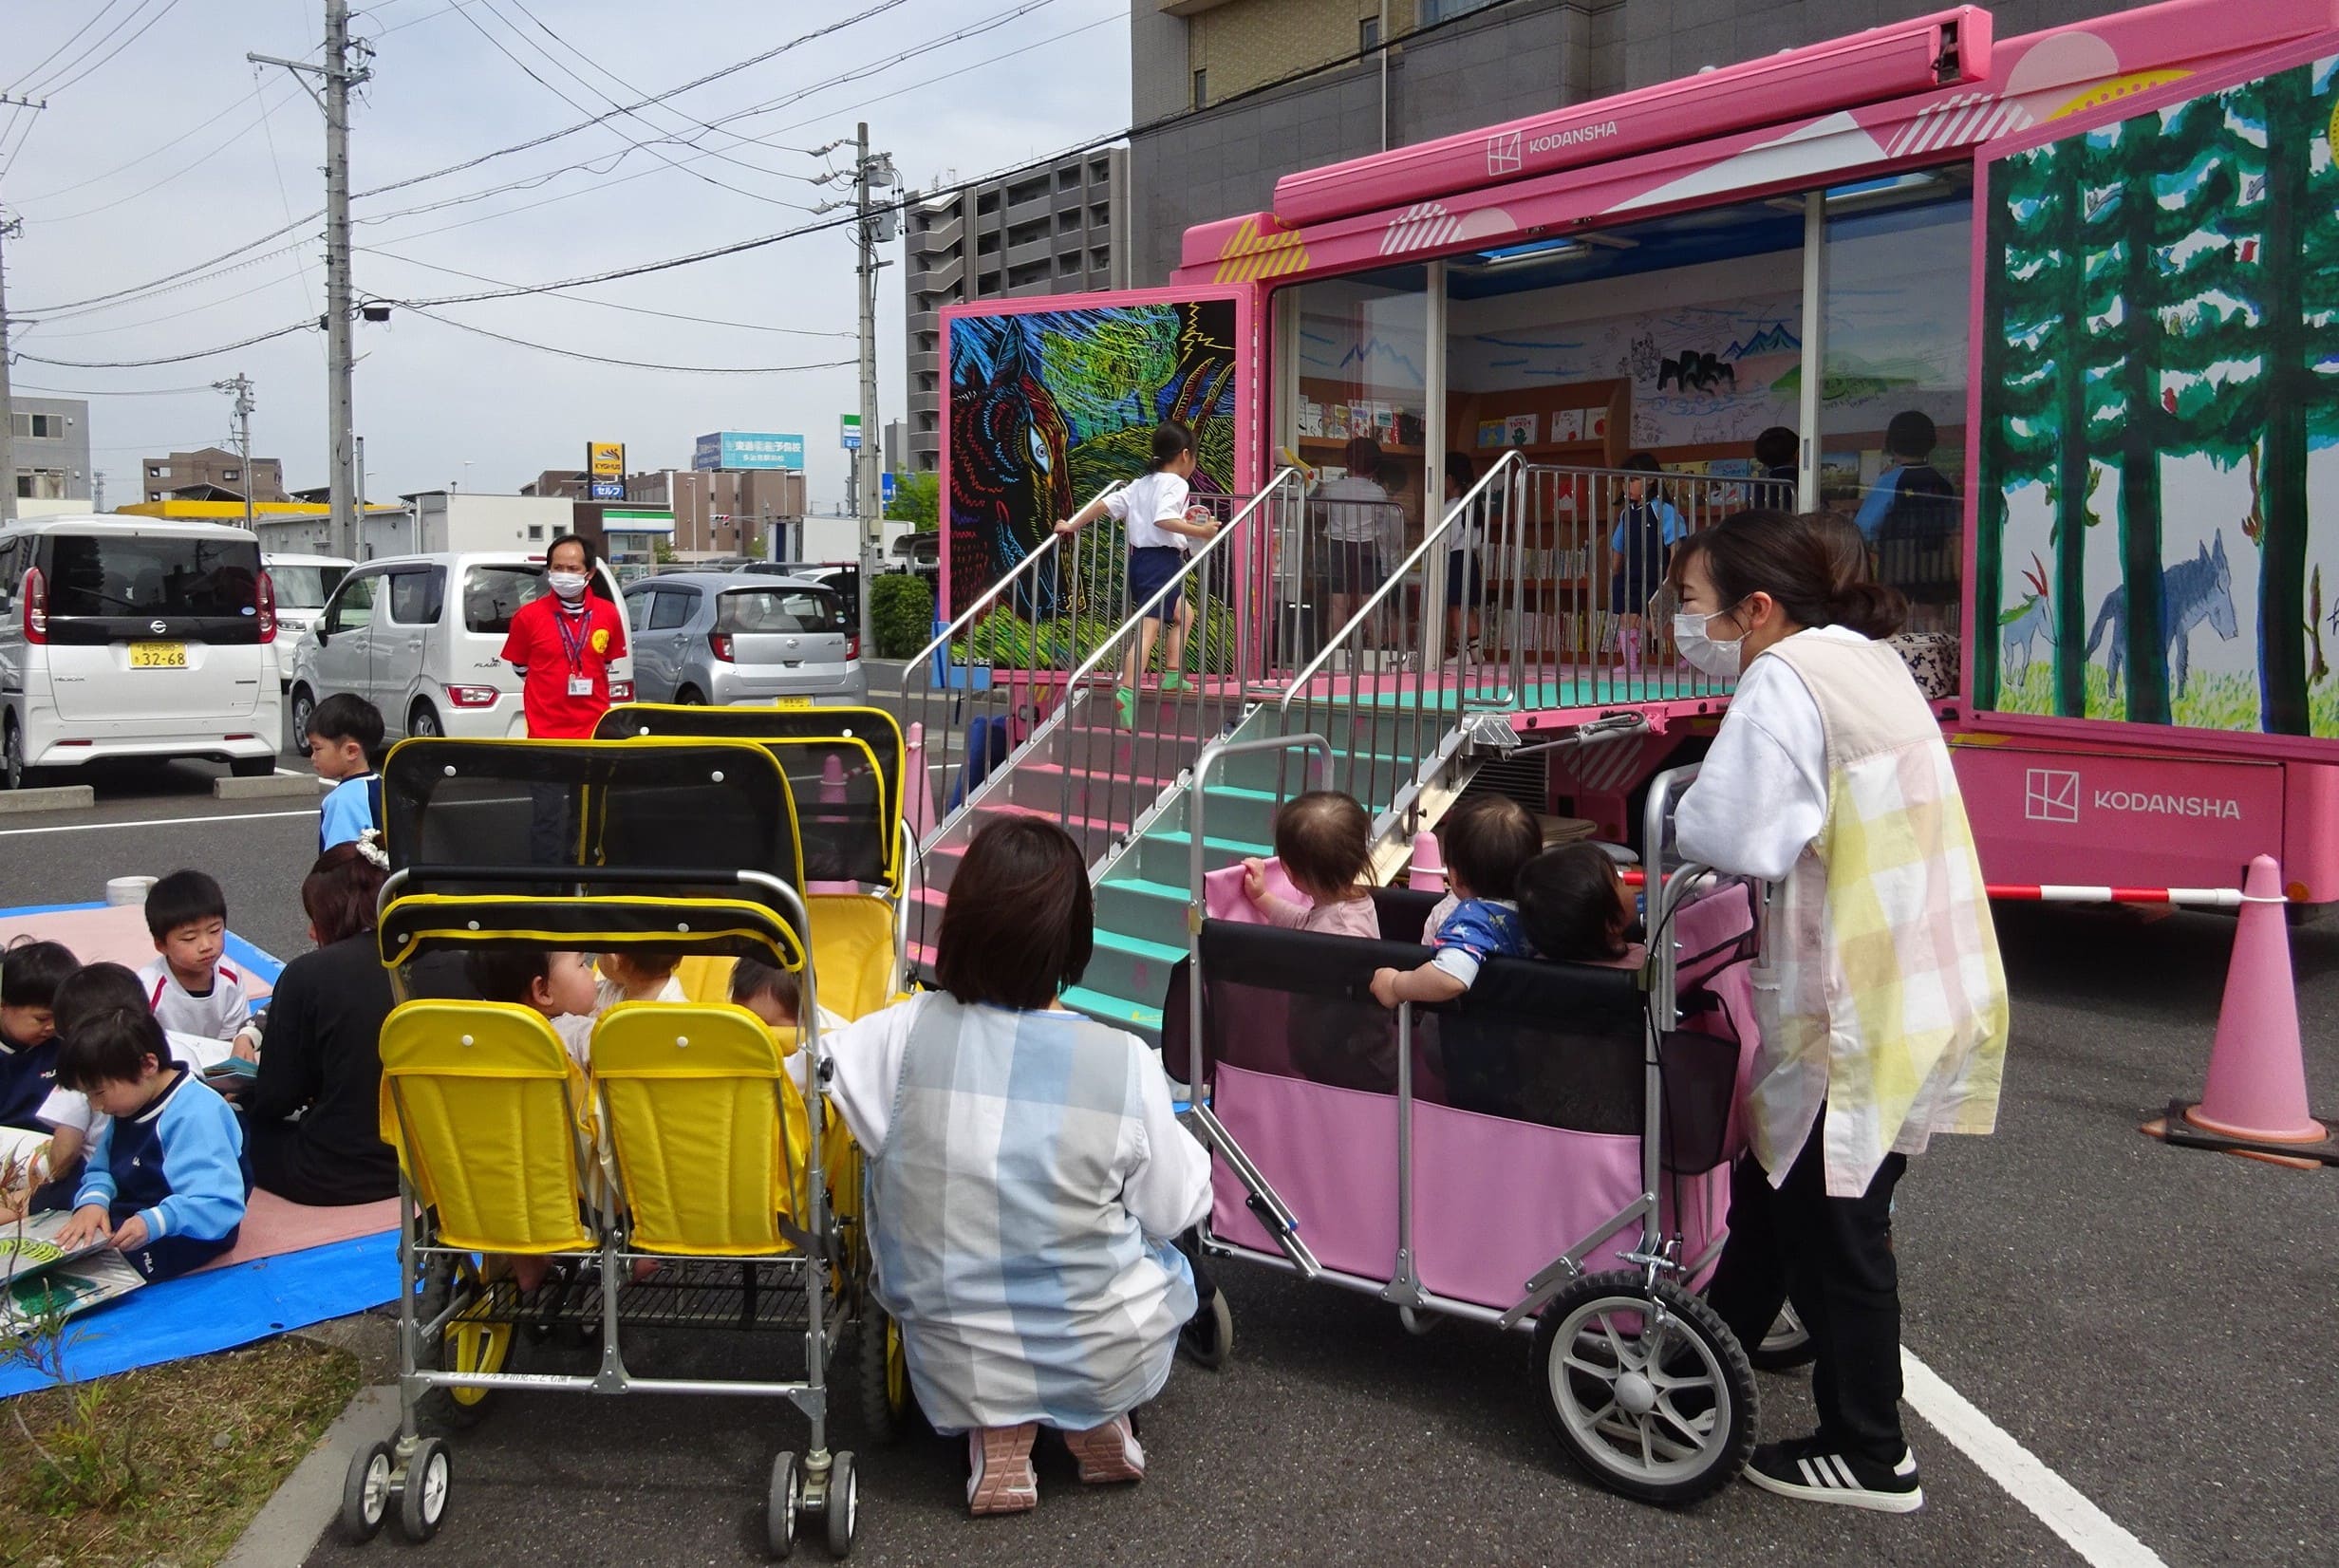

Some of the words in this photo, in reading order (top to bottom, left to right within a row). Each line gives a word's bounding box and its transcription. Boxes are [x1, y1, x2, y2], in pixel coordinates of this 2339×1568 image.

[1529, 121, 1618, 154] KODANSHA
[596, 486, 621, 495] セルフ
[142, 652, 185, 665] 32-68
[2094, 790, 2241, 820] KODANSHA
[142, 1252, 154, 1274] FILA
